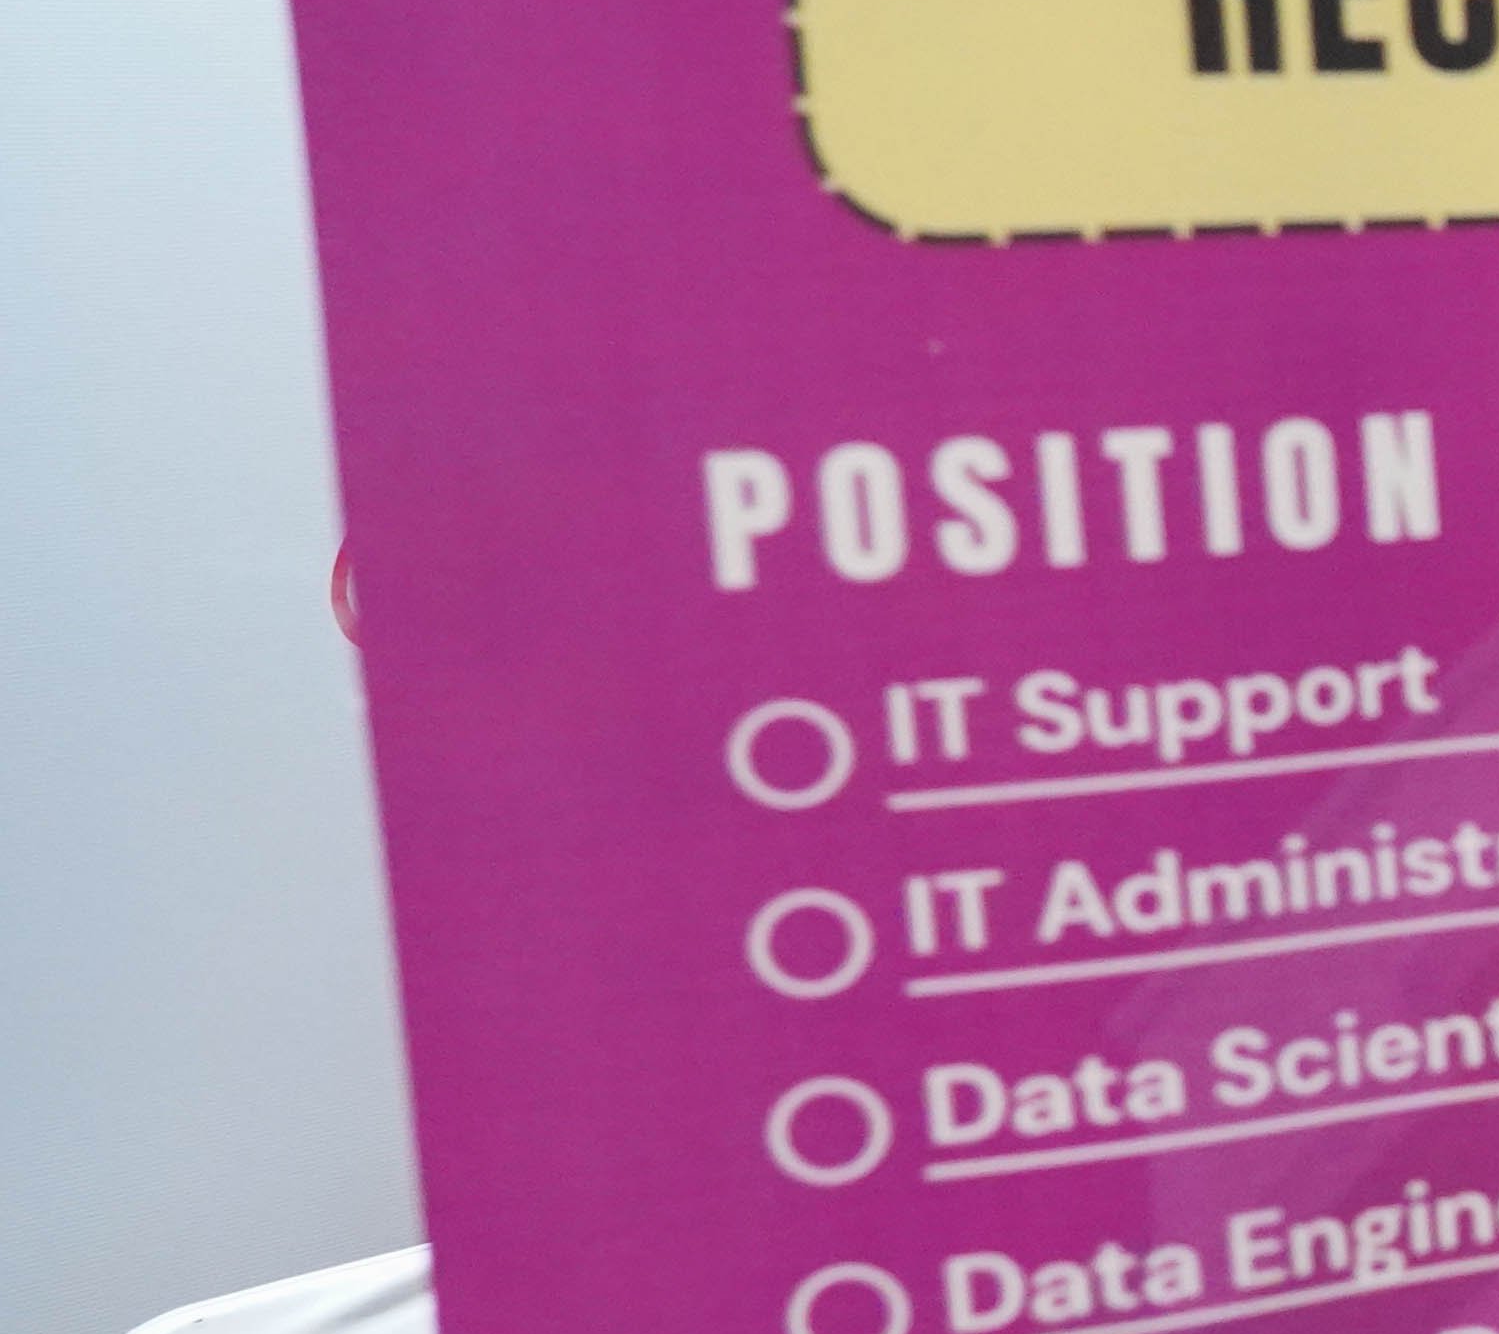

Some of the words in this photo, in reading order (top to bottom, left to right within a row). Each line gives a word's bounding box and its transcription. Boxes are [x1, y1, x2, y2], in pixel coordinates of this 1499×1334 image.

[704, 410, 1442, 590] POSITION
[887, 677, 985, 765] IT
[1014, 646, 1441, 759] Support
[904, 868, 1003, 956] IT
[924, 1049, 1187, 1146] Data
